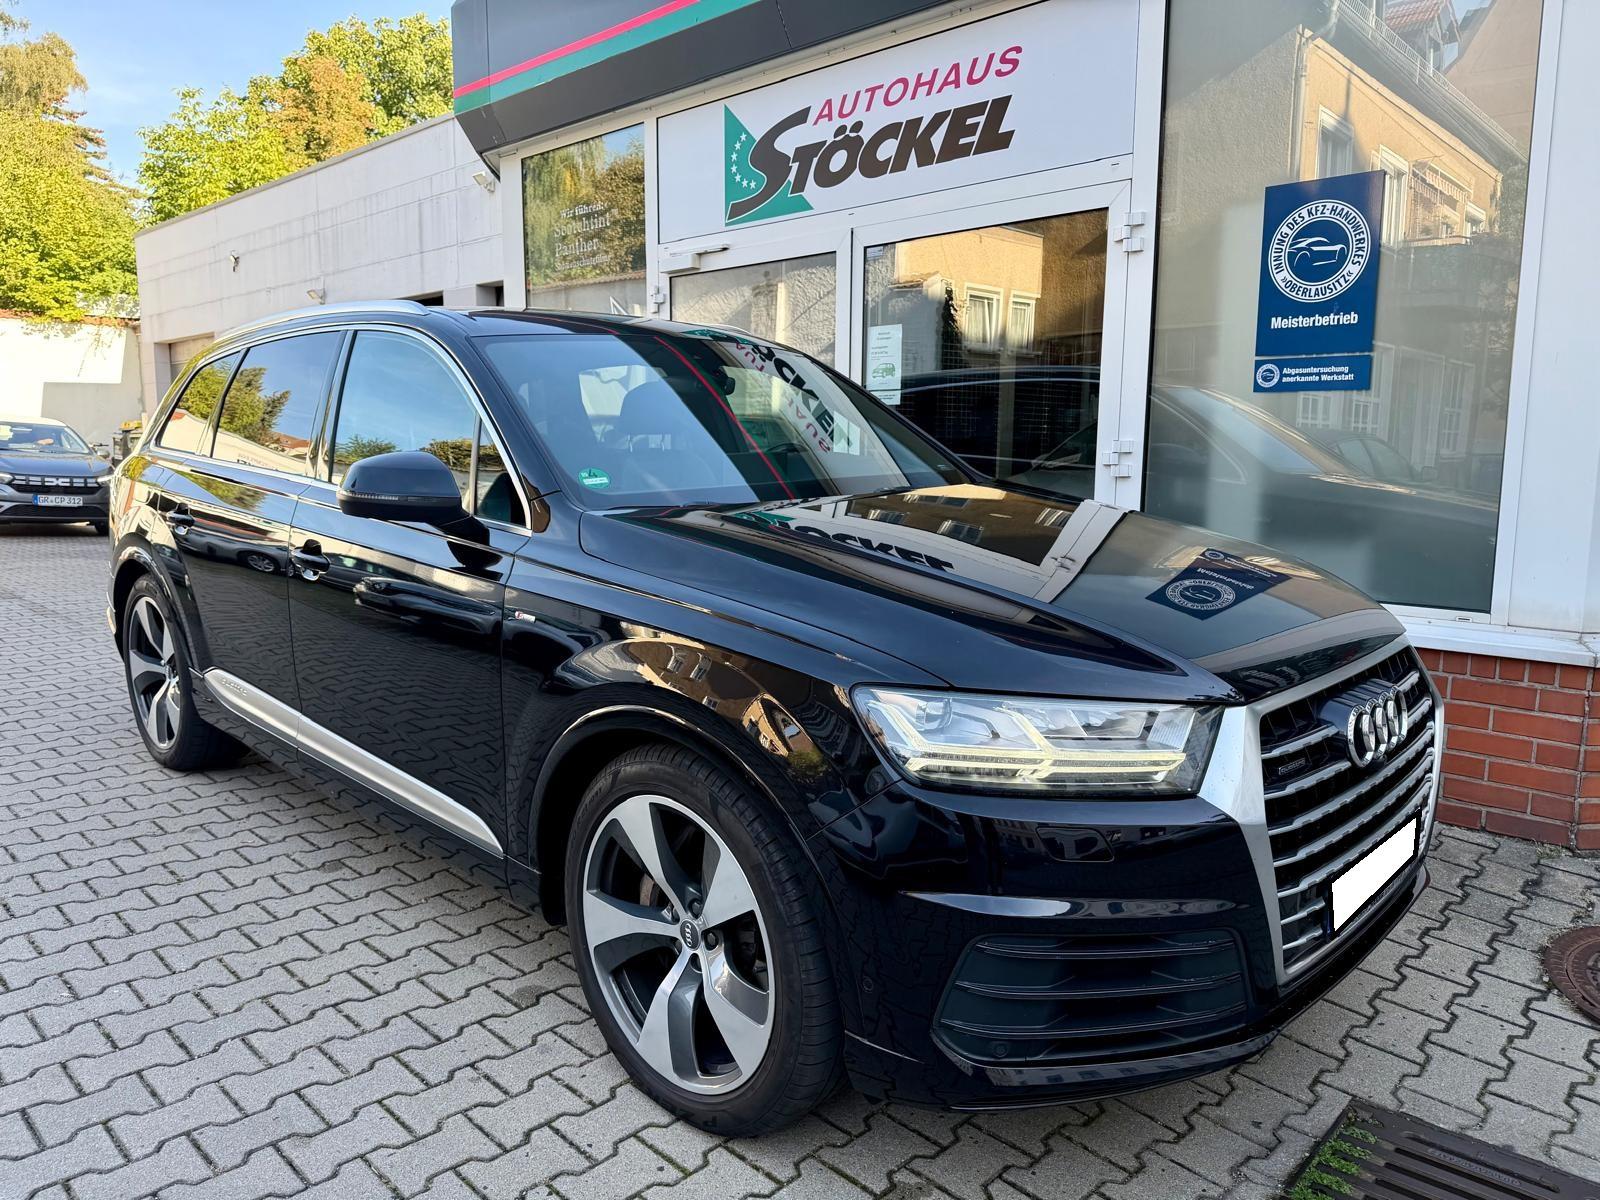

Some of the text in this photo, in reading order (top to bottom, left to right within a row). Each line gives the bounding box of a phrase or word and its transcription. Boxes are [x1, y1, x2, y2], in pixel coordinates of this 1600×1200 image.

[813, 45, 1023, 126] AUTOHAUS
[726, 94, 1016, 222] STÖCKEL
[560, 208, 573, 219] Wir
[1273, 204, 1366, 275] INNUNG DES KFZ-HANDWERKES
[1271, 311, 1359, 329] Meisterbetrieb
[1282, 366, 1349, 375] Abgasuntersuchung
[1282, 373, 1354, 383] anerkannte Werkstatt
[38, 496, 82, 505] GR CP 312
